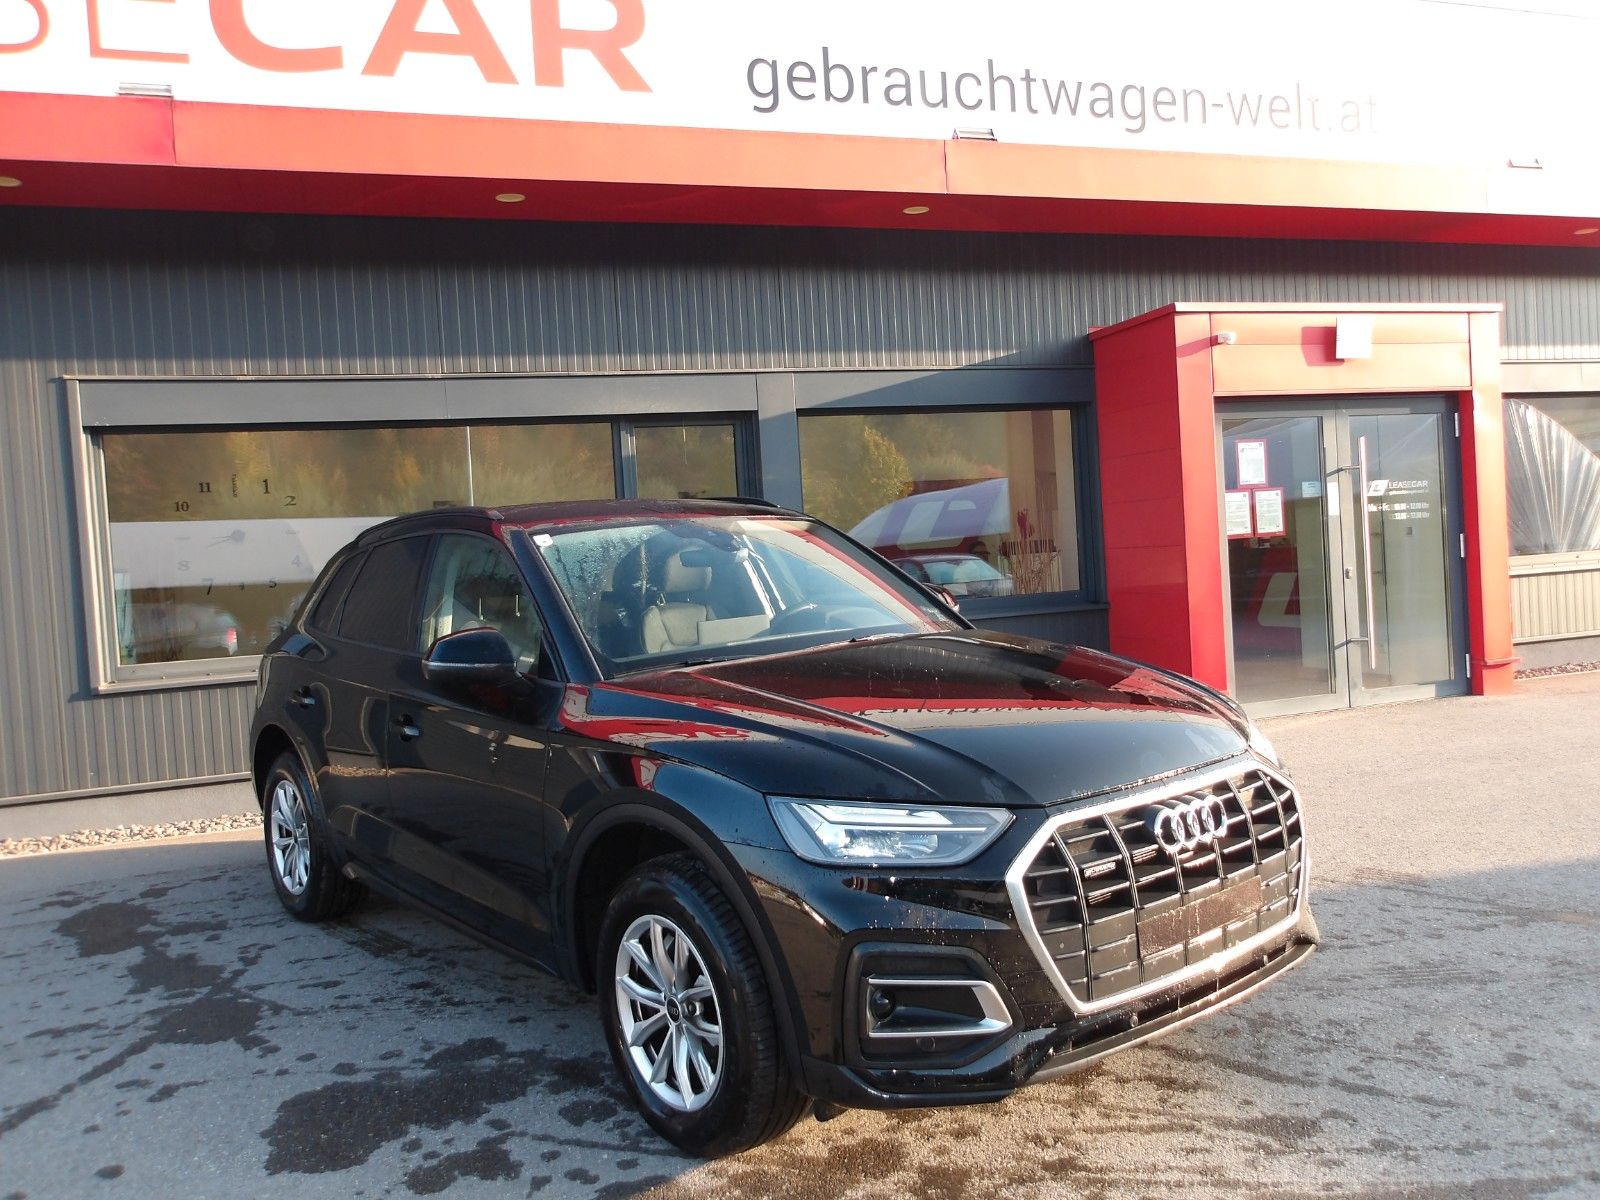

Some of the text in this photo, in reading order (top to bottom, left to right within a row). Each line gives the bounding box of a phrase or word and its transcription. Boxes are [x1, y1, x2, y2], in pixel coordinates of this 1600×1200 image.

[746, 46, 1379, 134] gebrauchtwagen-welt.at
[199, 482, 212, 493] 11
[262, 479, 271, 494] 1
[1388, 480, 1429, 489] LEASECAR
[174, 501, 190, 512] 10
[283, 495, 297, 507] 2
